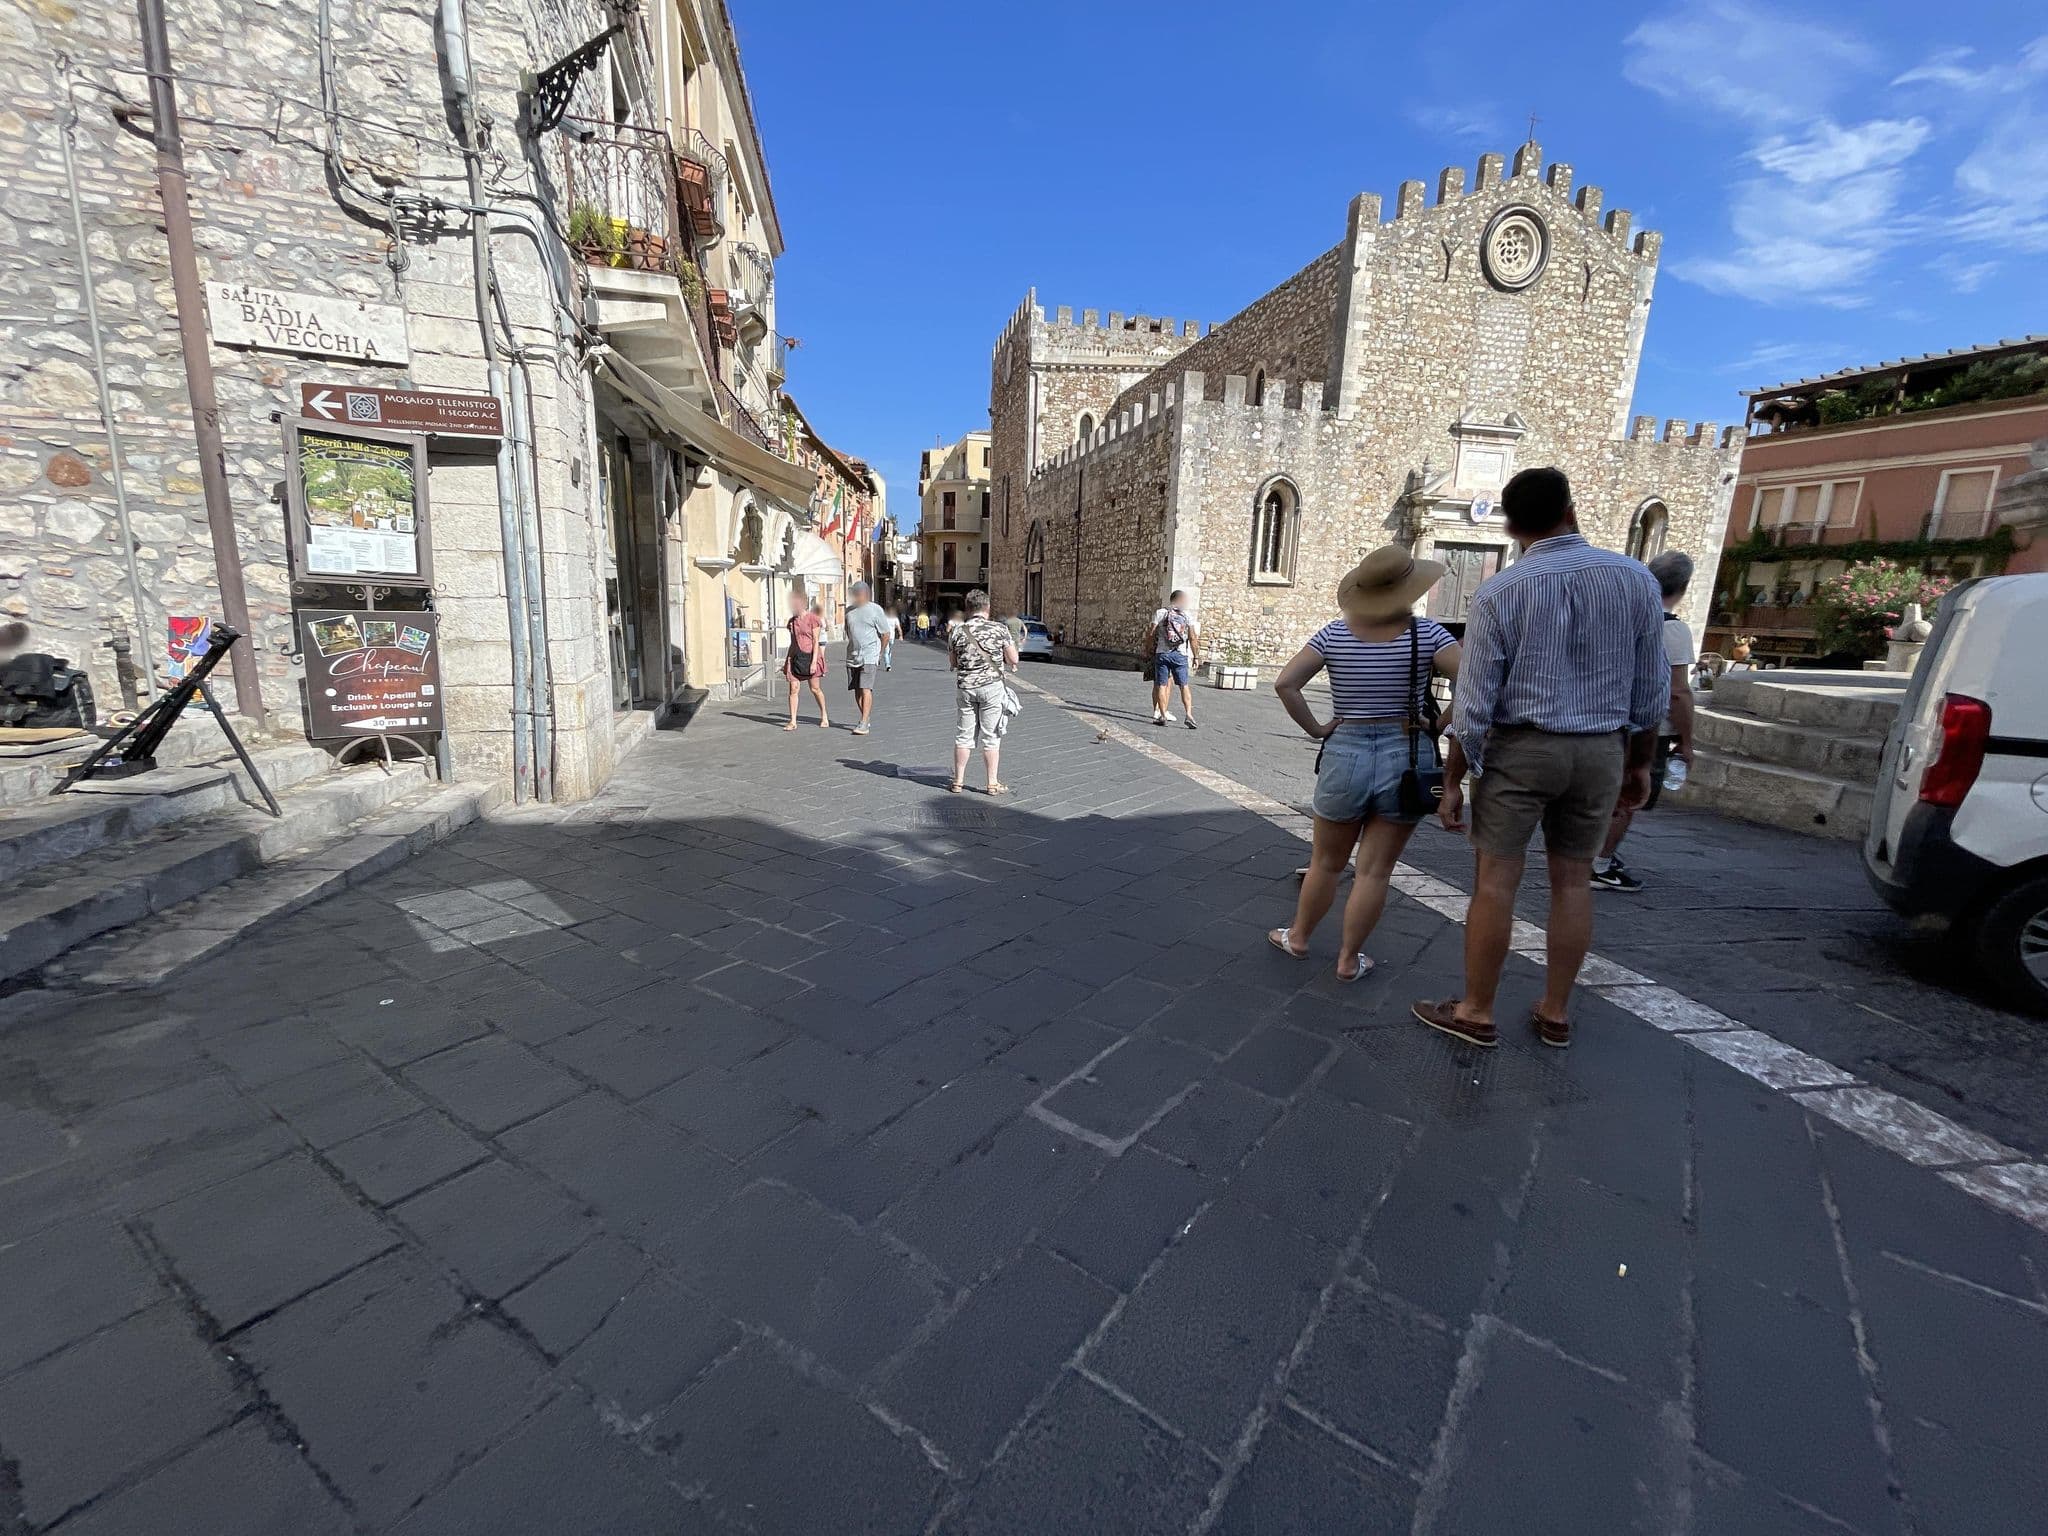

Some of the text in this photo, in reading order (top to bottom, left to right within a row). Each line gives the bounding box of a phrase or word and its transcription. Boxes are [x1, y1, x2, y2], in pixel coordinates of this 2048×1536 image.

[221, 288, 283, 307] SALITA
[241, 304, 323, 331] BADIA
[265, 325, 379, 356] VECCHIA
[384, 394, 496, 410] MOSAICO ELLENISTICO
[448, 410, 480, 419] SECOLO
[303, 435, 343, 449] Pizzeria
[347, 693, 374, 701] Drink
[331, 703, 378, 712] Exclusive
[380, 701, 415, 710] Lounge
